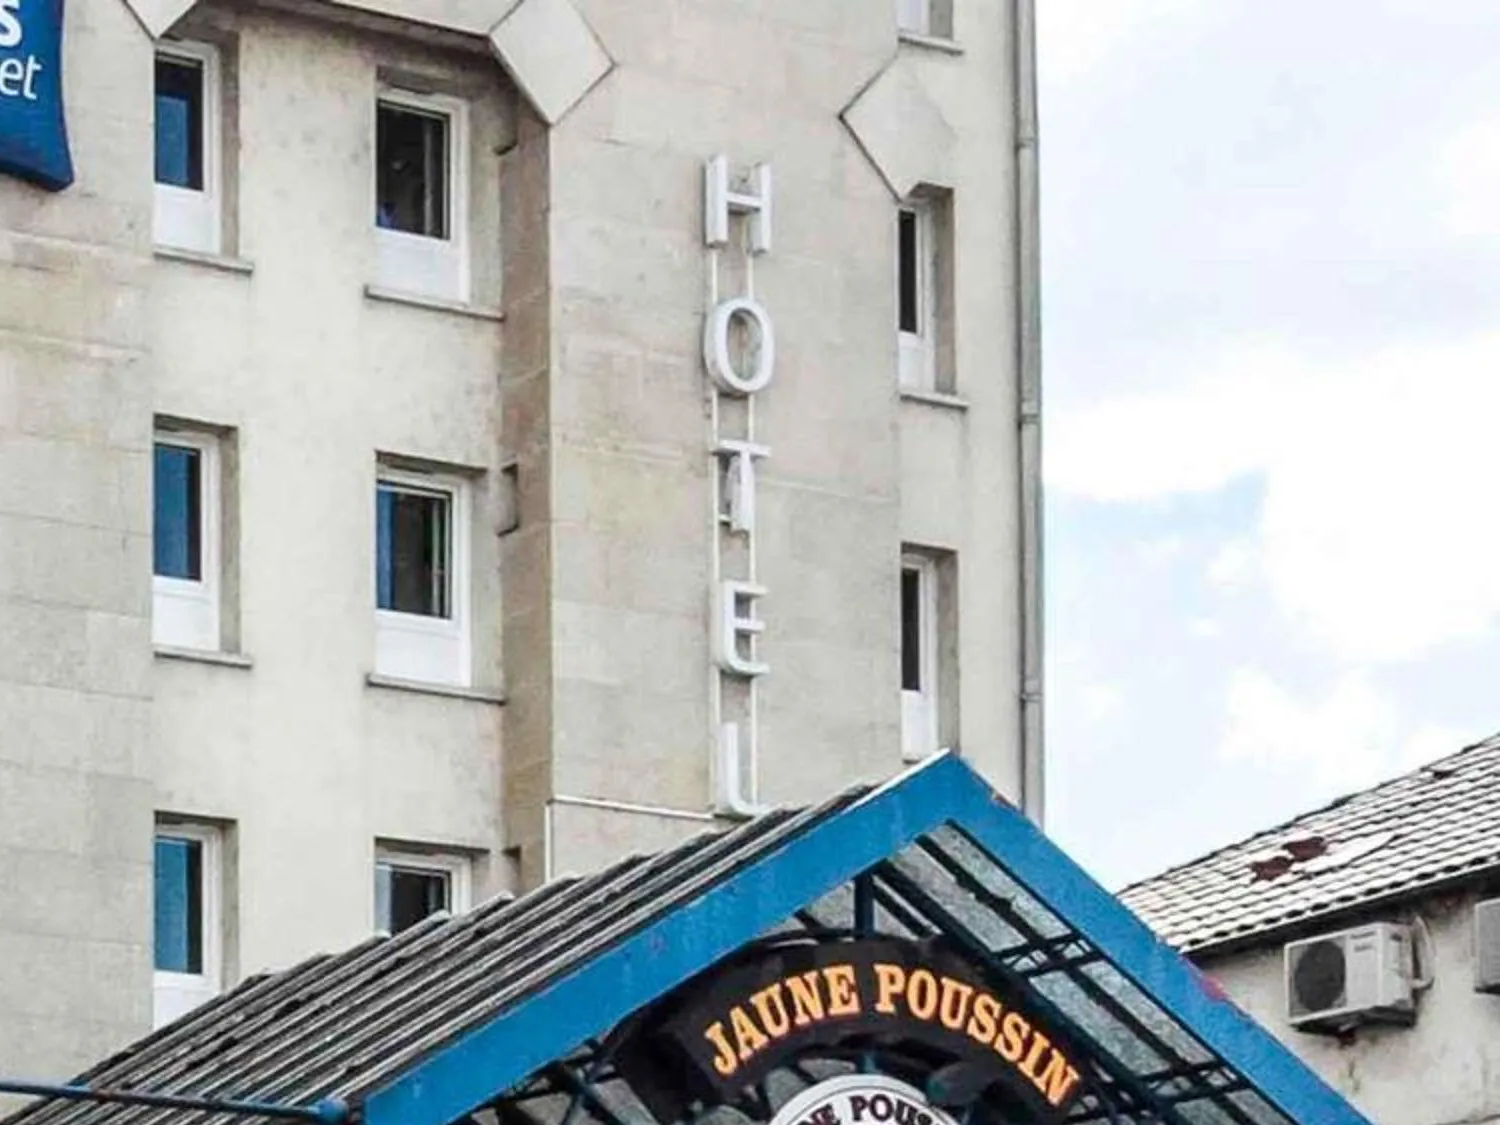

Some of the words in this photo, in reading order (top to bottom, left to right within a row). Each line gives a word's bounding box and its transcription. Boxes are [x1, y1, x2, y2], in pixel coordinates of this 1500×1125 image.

[704, 153, 774, 818] HOTEL
[704, 963, 860, 1077] JAUNE
[873, 962, 1081, 1107] POUSSIN
